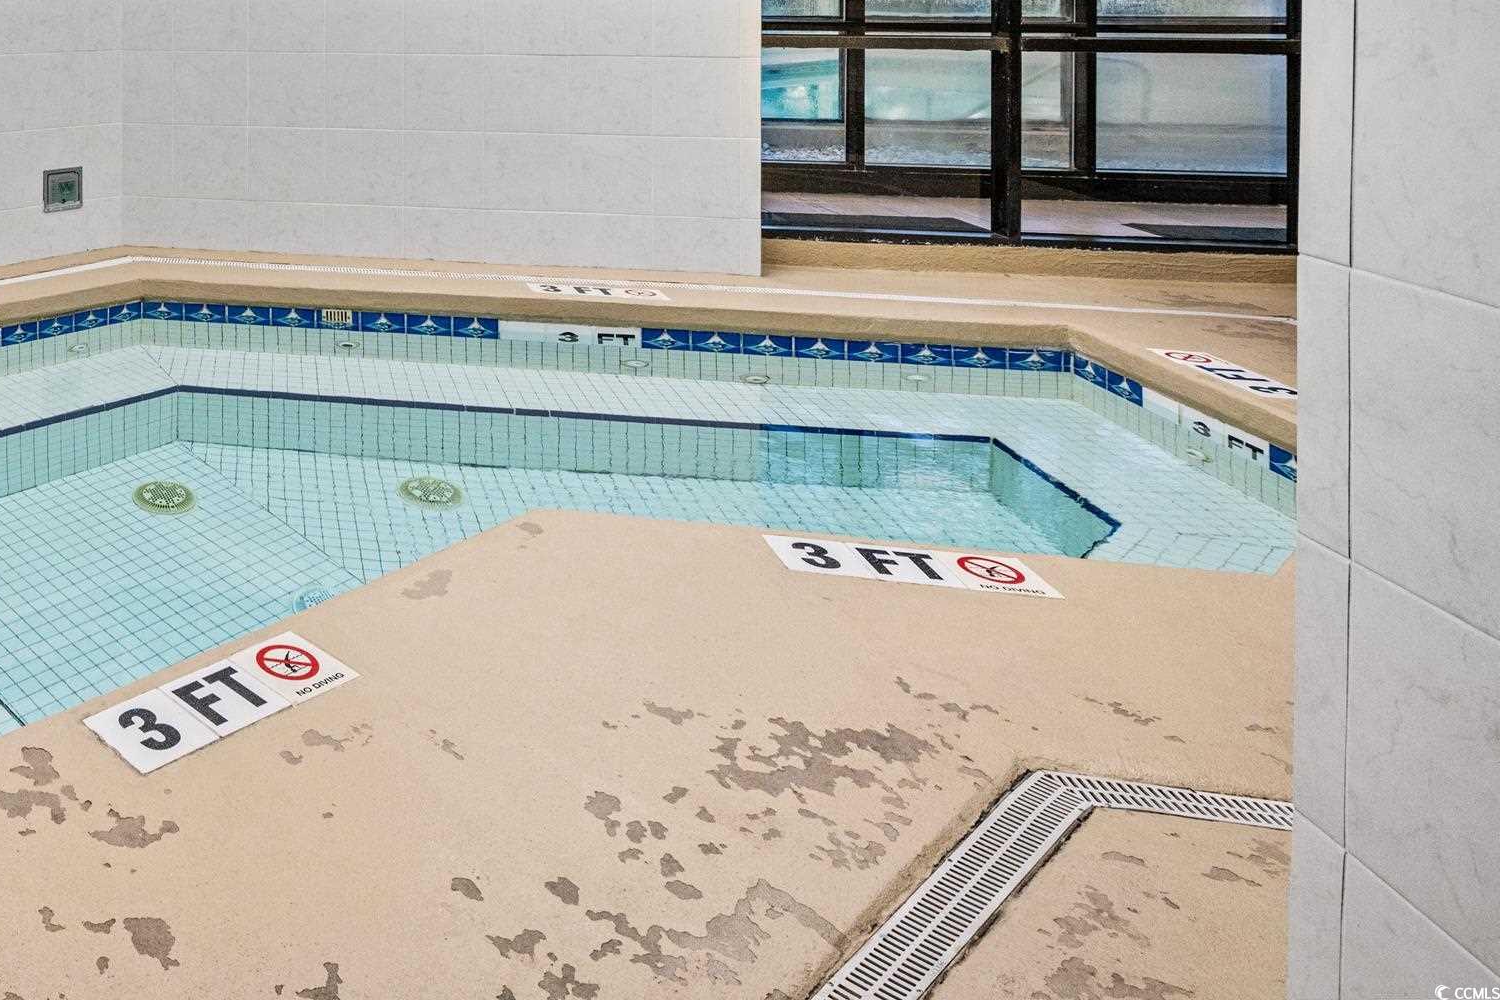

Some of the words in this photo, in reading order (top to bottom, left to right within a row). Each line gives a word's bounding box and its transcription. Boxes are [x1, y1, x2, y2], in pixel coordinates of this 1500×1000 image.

[540, 284, 562, 293] 3
[573, 286, 612, 296] FT
[558, 332, 579, 343] 3
[598, 333, 635, 346] FT
[1192, 421, 1211, 438] 3
[1228, 434, 1264, 460] FT
[791, 542, 841, 569] 3
[855, 548, 944, 581] FT
[296, 687, 313, 696] NO
[312, 672, 344, 689] DIVING
[118, 708, 181, 751] 3
[172, 666, 268, 726] FT
